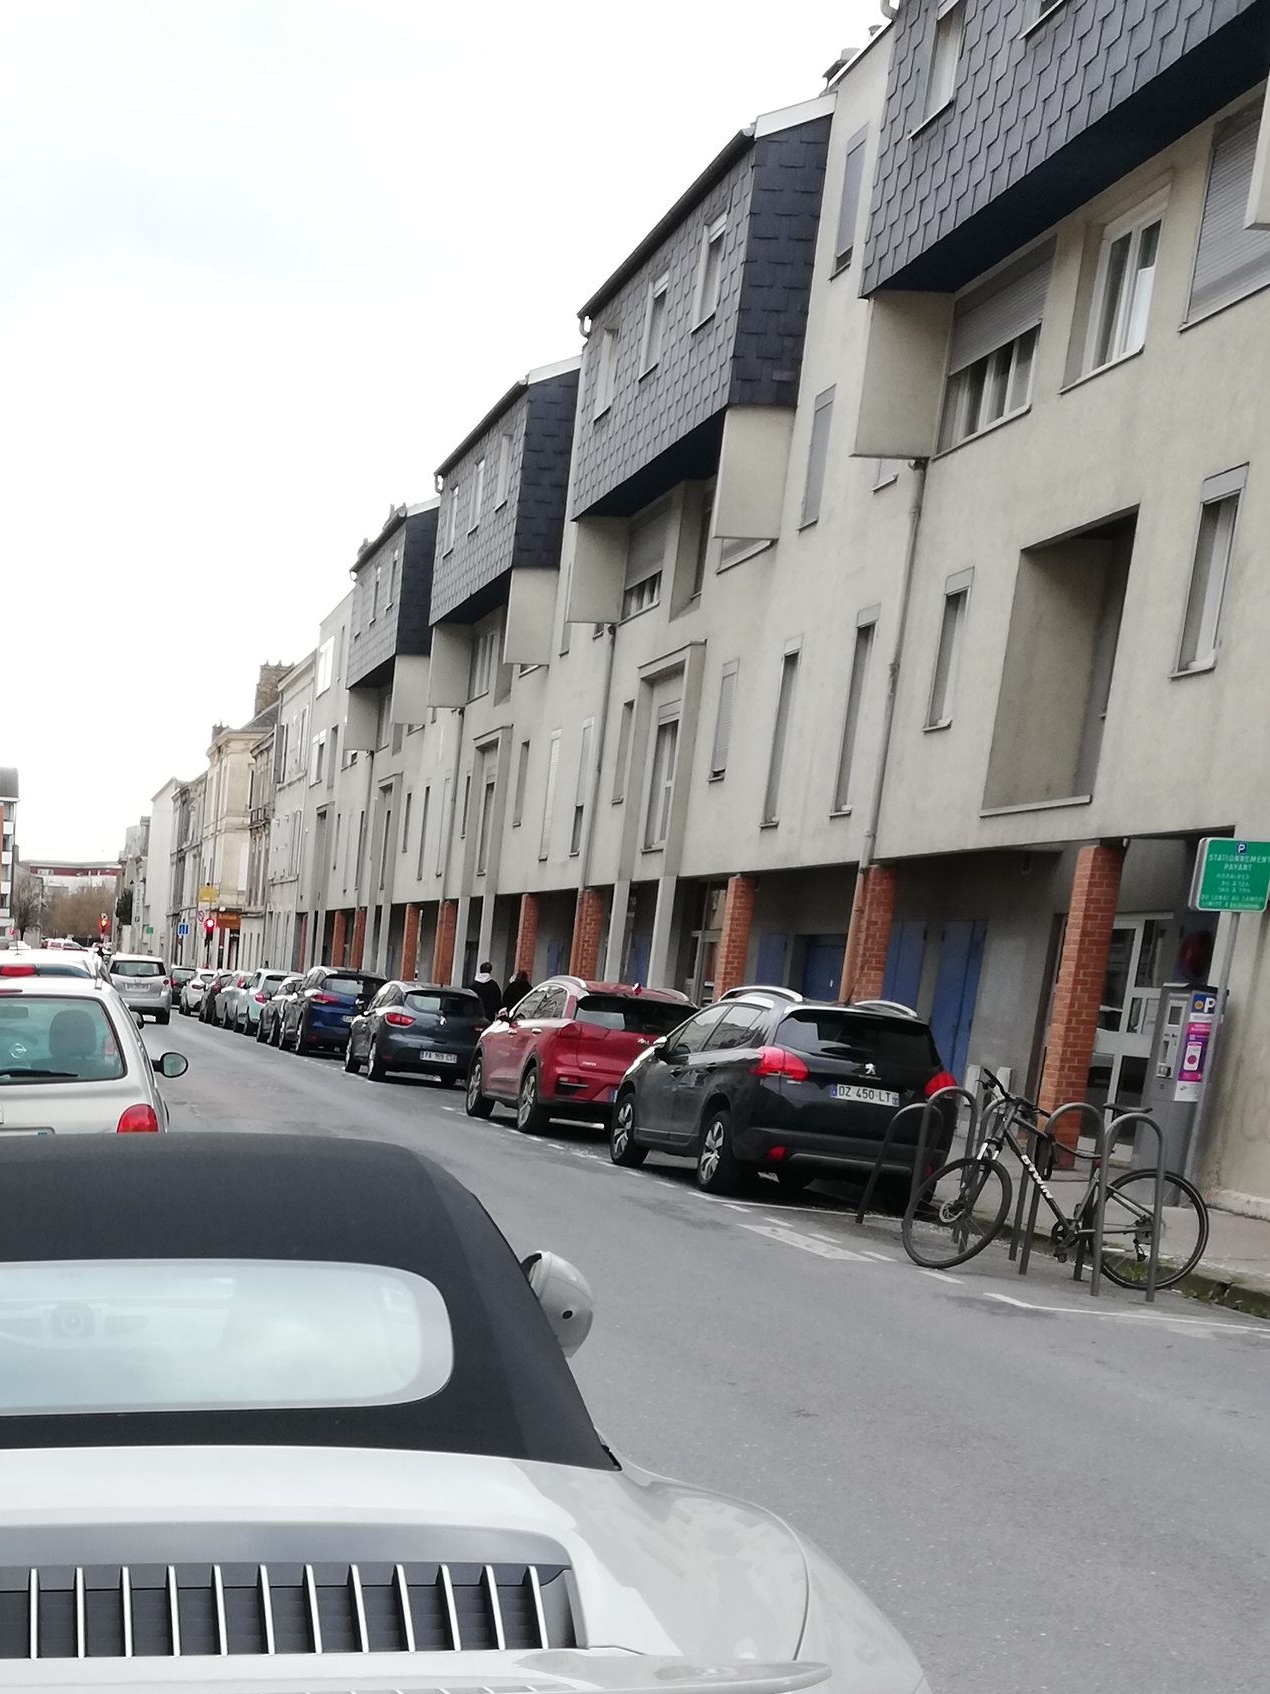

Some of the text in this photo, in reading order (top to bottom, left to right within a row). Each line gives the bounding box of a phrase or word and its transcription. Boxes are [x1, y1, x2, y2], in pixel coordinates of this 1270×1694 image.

[1237, 843, 1246, 853] P
[1223, 863, 1253, 871] PAYANT
[1204, 998, 1216, 1013] P
